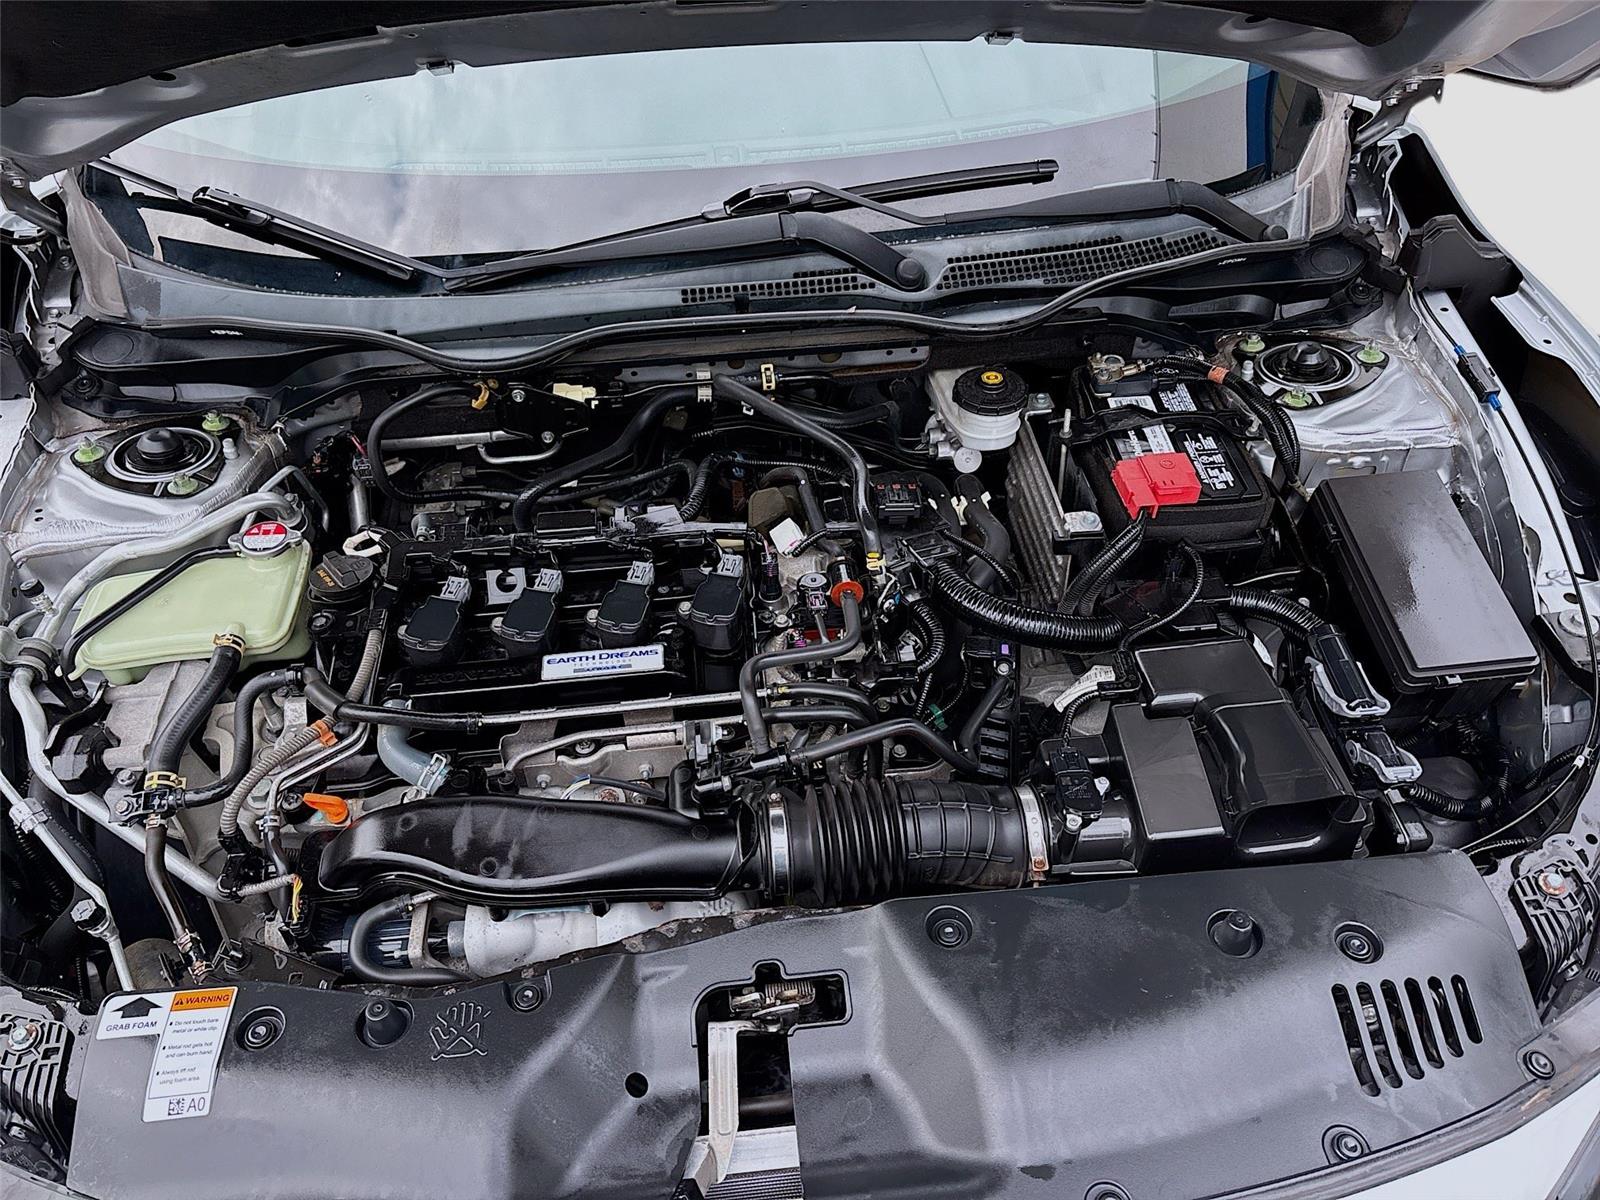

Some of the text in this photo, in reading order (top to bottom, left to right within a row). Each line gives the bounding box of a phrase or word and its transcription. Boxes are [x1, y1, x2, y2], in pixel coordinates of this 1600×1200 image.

[546, 649, 659, 665] EARTH DREAMS
[184, 994, 230, 1005] WARNING
[105, 1020, 158, 1032] GRAB FOAM
[186, 1096, 206, 1113] A0
